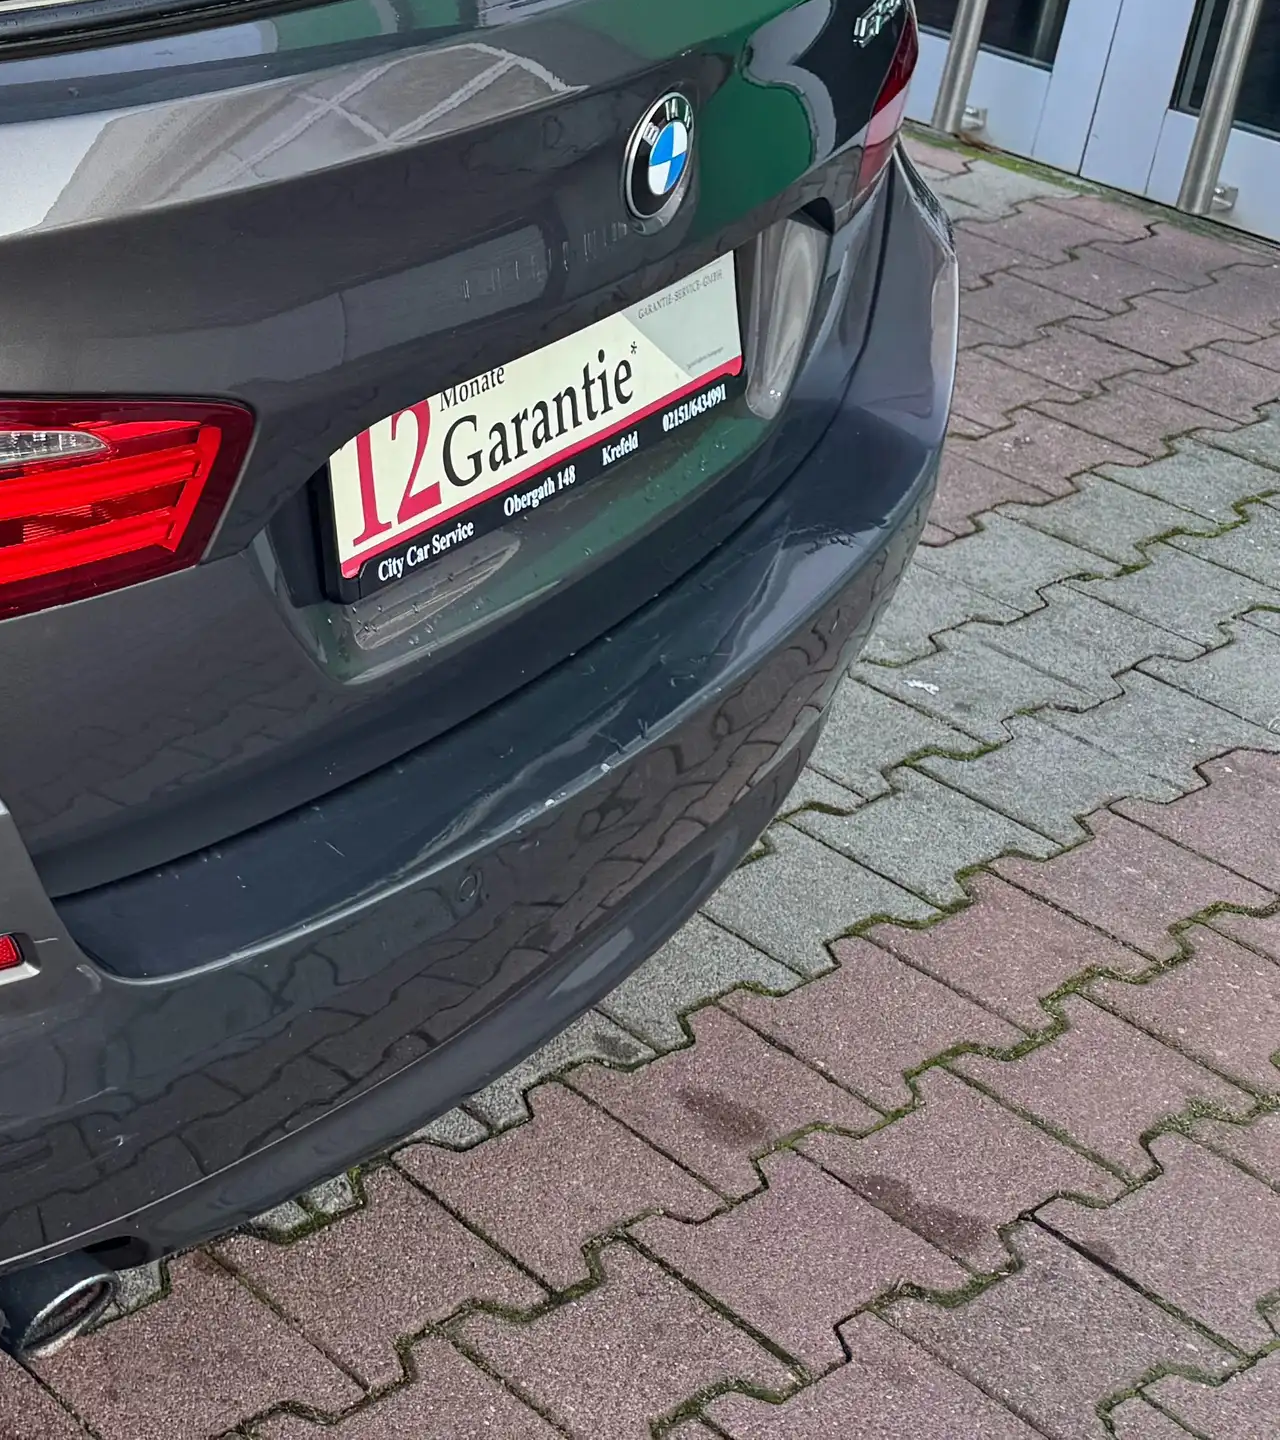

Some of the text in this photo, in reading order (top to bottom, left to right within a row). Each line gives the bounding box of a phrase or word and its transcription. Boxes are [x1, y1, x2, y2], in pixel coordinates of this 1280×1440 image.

[440, 366, 505, 412] Monate
[351, 399, 442, 547] 12
[378, 383, 727, 582] City Car Service Obergath 148 Krefeld 02151/6434991
